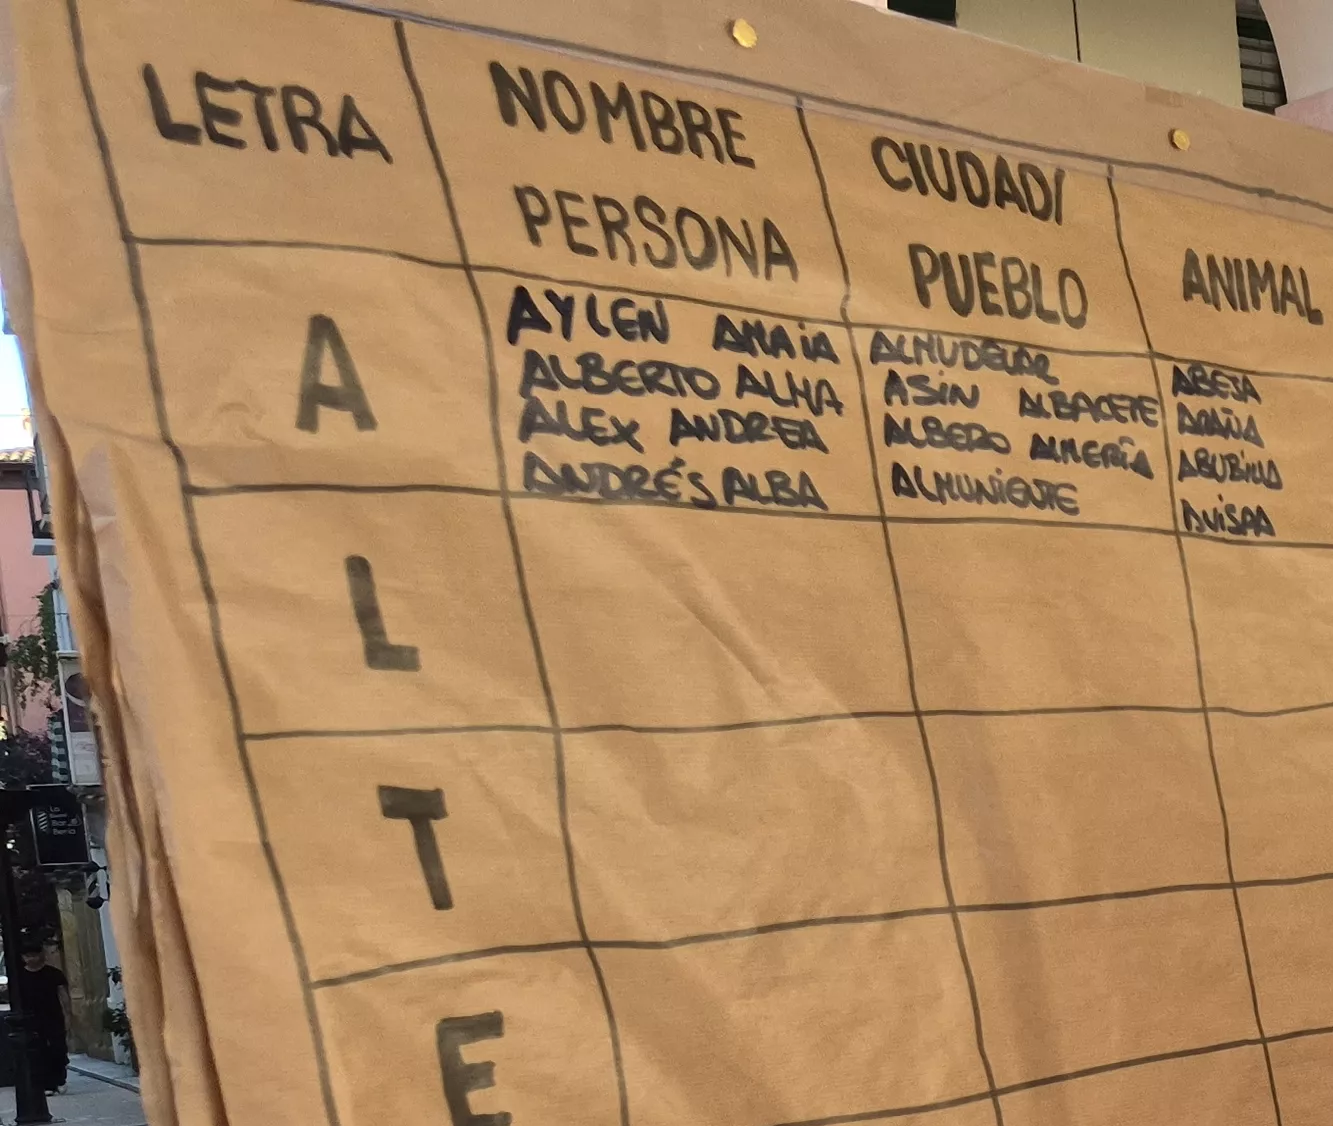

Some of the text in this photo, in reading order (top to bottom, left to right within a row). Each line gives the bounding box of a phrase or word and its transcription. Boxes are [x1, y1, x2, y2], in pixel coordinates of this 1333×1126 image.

[142, 62, 393, 164] LETRA
[489, 60, 757, 171] NOMBRE
[513, 184, 800, 282] PERSONA
[506, 285, 670, 345] AYLEN
[908, 242, 1088, 329] PUEBLO
[1181, 247, 1324, 325] ANIMAL
[295, 314, 378, 433] A
[519, 349, 721, 401] ALBERTO
[518, 399, 829, 454] ALEX ANDREA
[722, 466, 829, 511] ALBA
[344, 554, 421, 671] L
[377, 785, 454, 911] T
